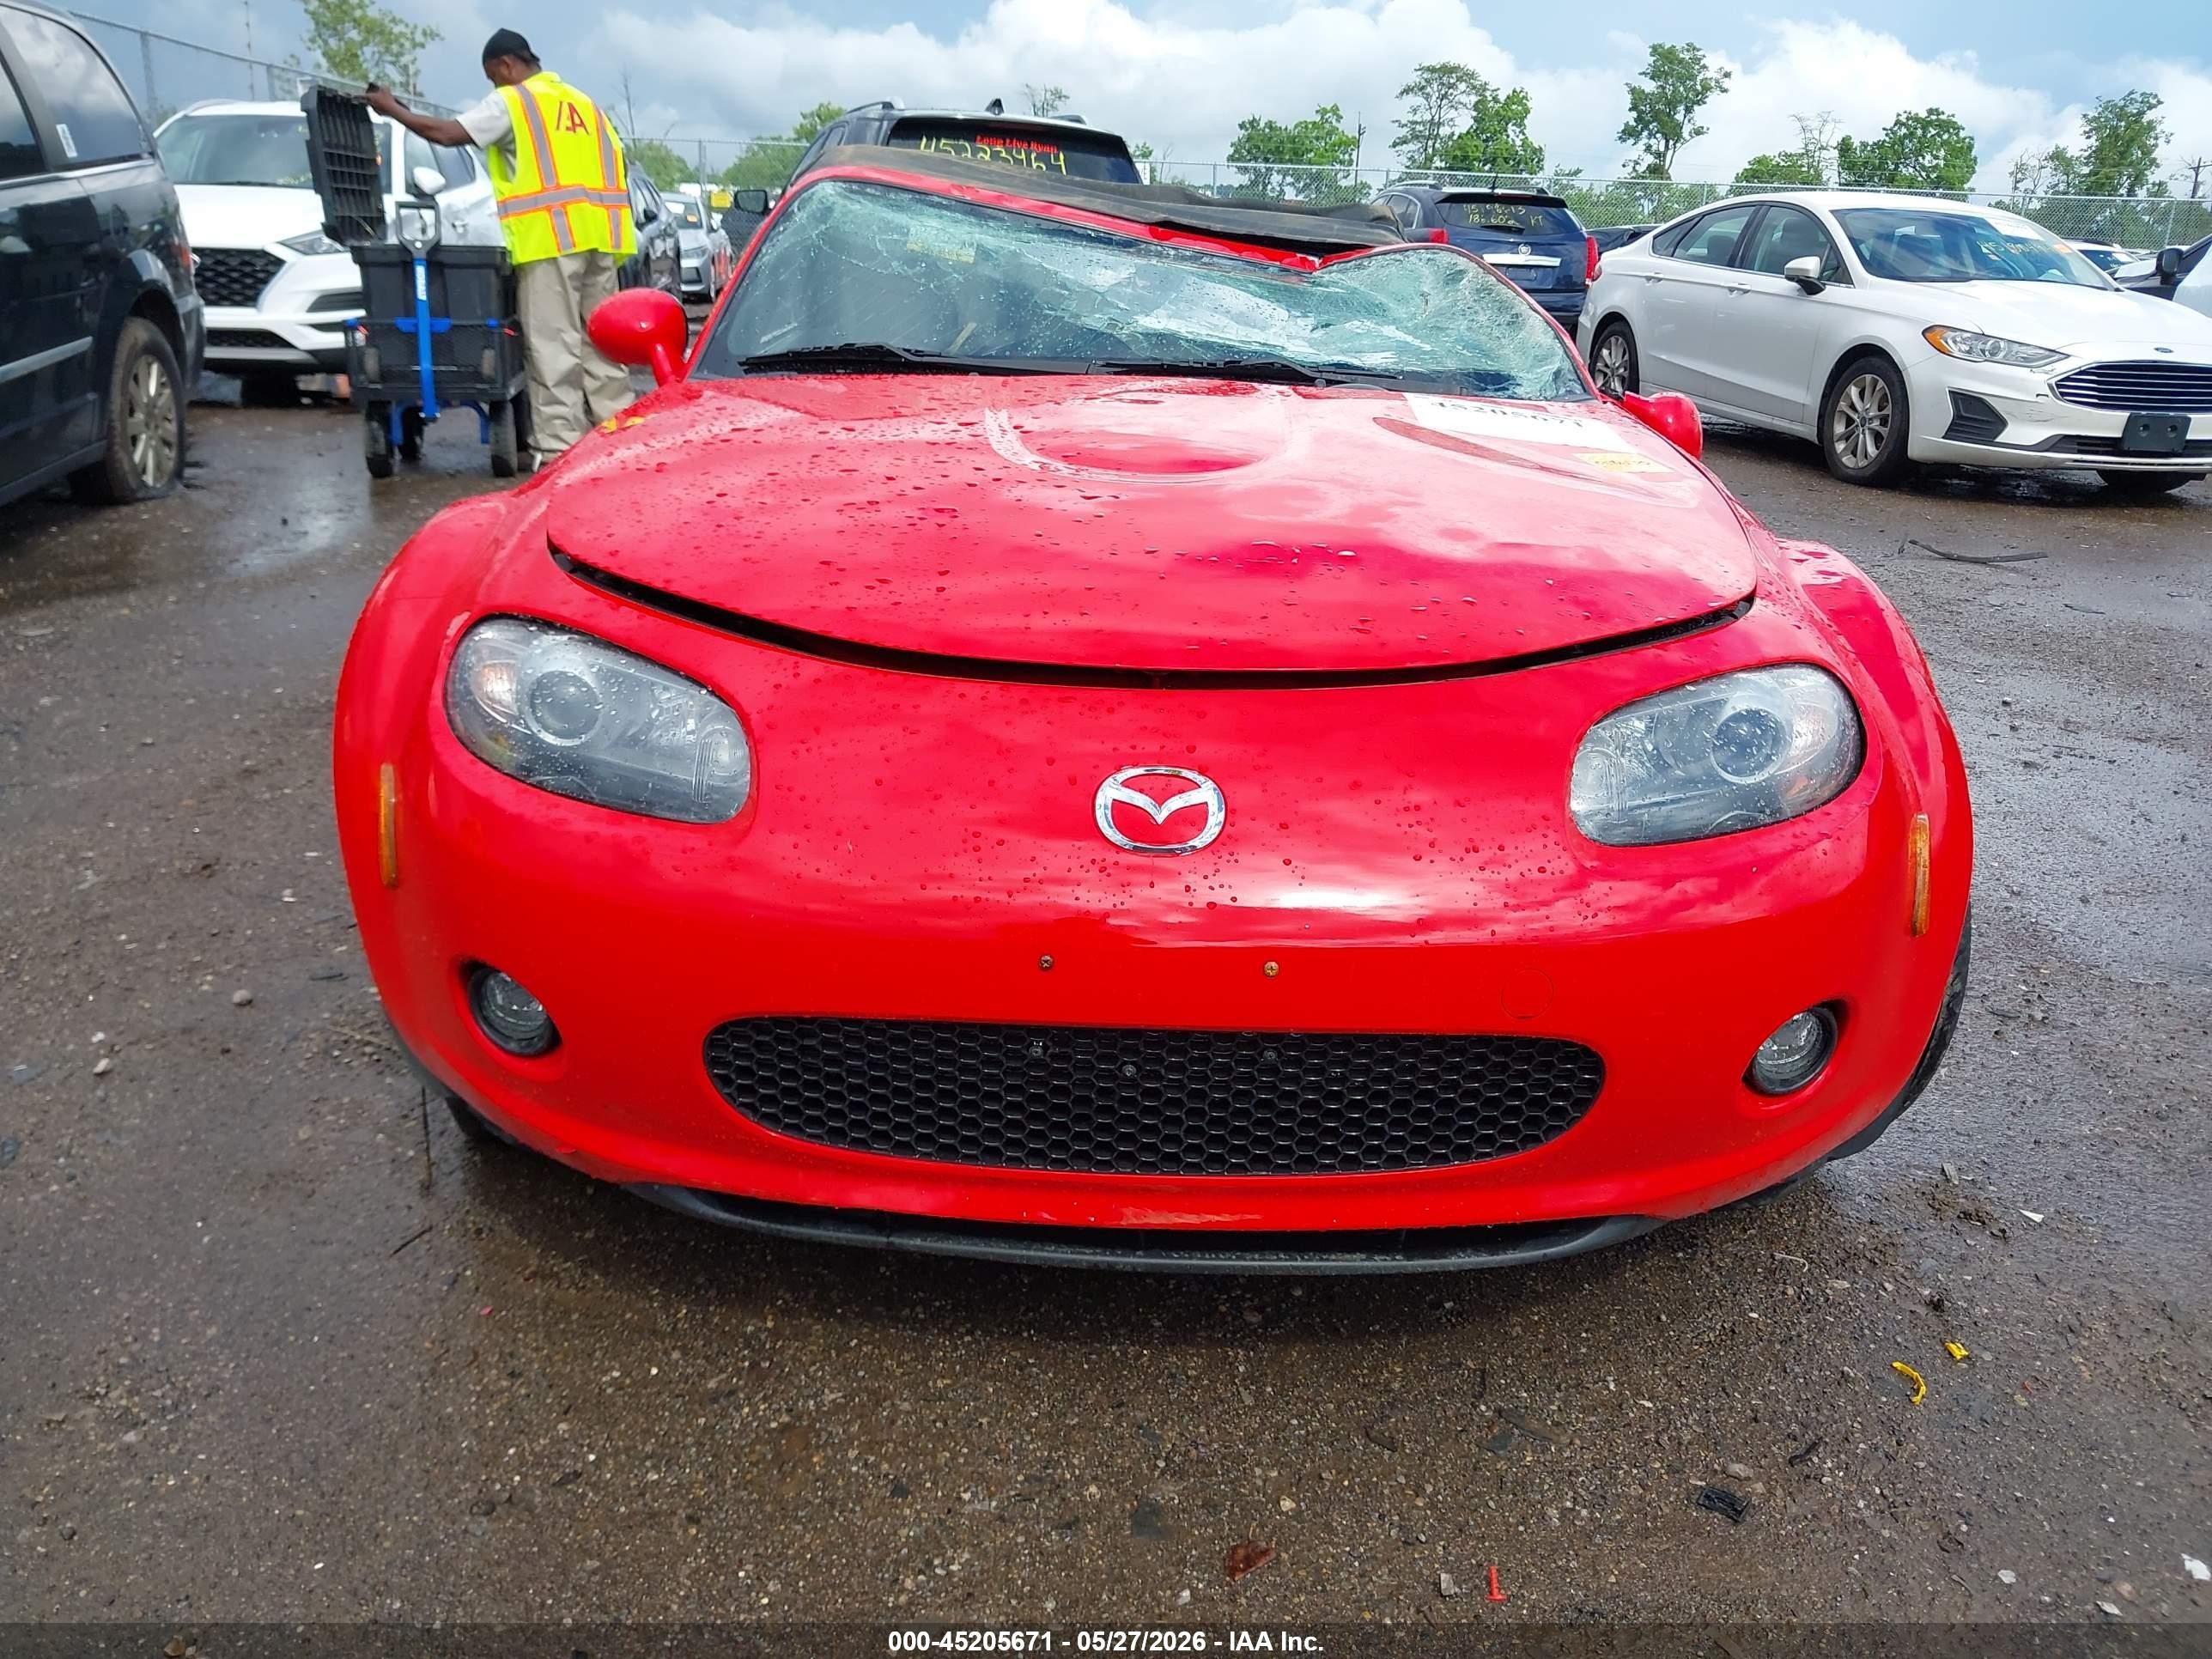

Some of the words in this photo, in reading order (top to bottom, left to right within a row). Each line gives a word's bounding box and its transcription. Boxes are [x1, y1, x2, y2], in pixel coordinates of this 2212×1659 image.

[975, 135, 1004, 148] Long
[1005, 137, 1029, 149] Live
[1030, 140, 1059, 154] Ryan
